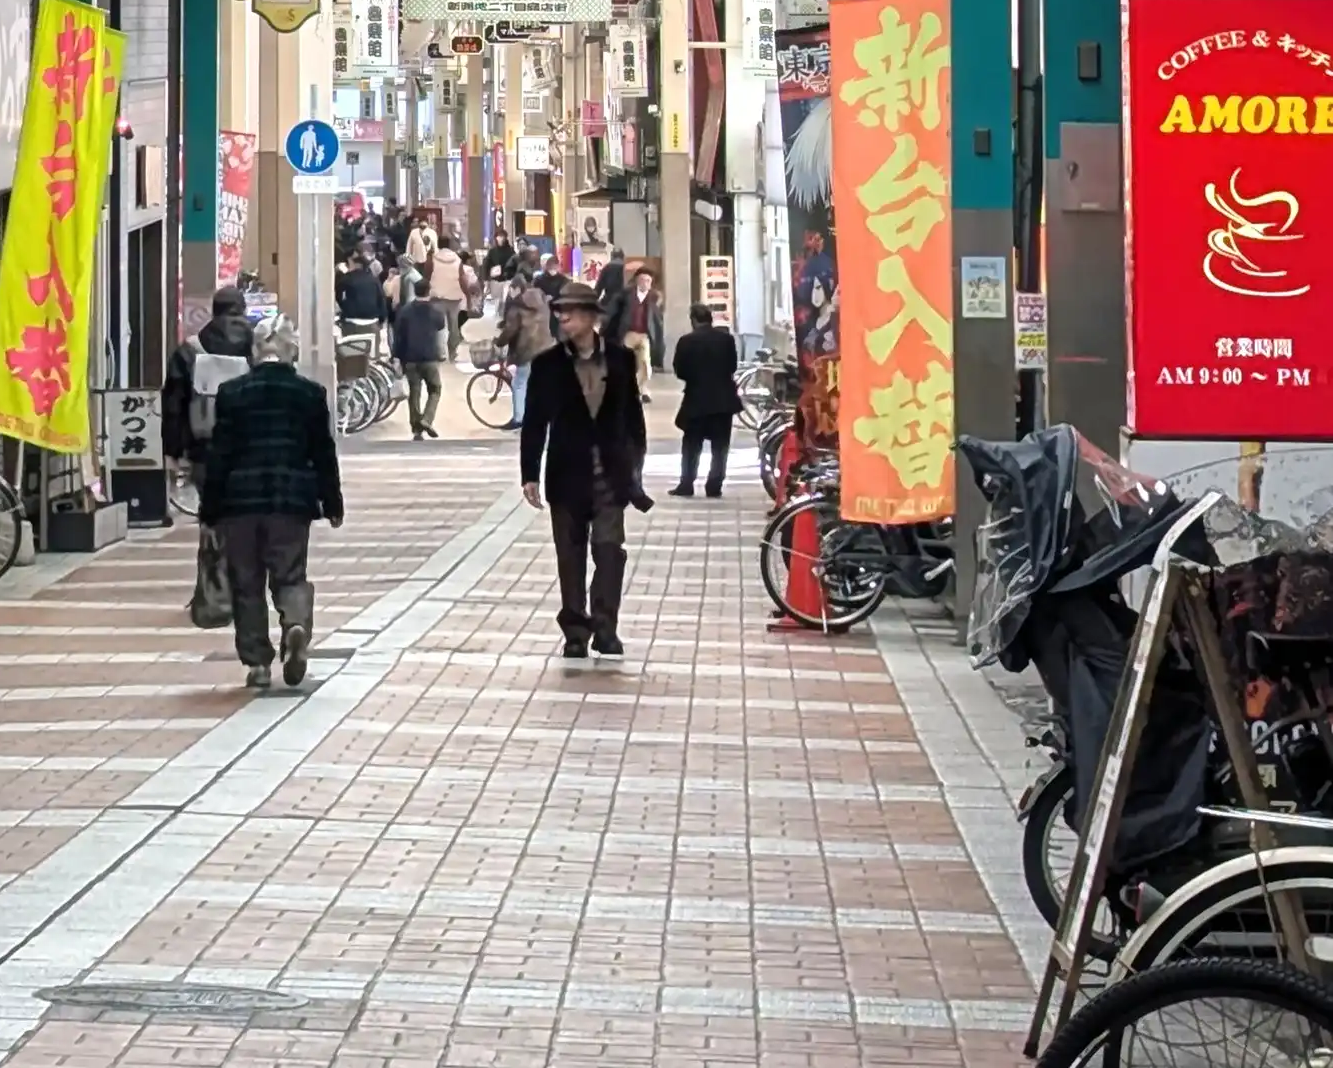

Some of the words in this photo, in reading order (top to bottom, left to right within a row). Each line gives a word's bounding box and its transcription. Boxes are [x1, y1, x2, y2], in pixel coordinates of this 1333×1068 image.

[1157, 30, 1247, 82] COFFEE
[1251, 30, 1271, 48] &
[1215, 337, 1293, 360] 営業時間
[1156, 366, 1194, 386] AM
[1199, 366, 1242, 386] 9:00
[1276, 366, 1311, 386] PM
